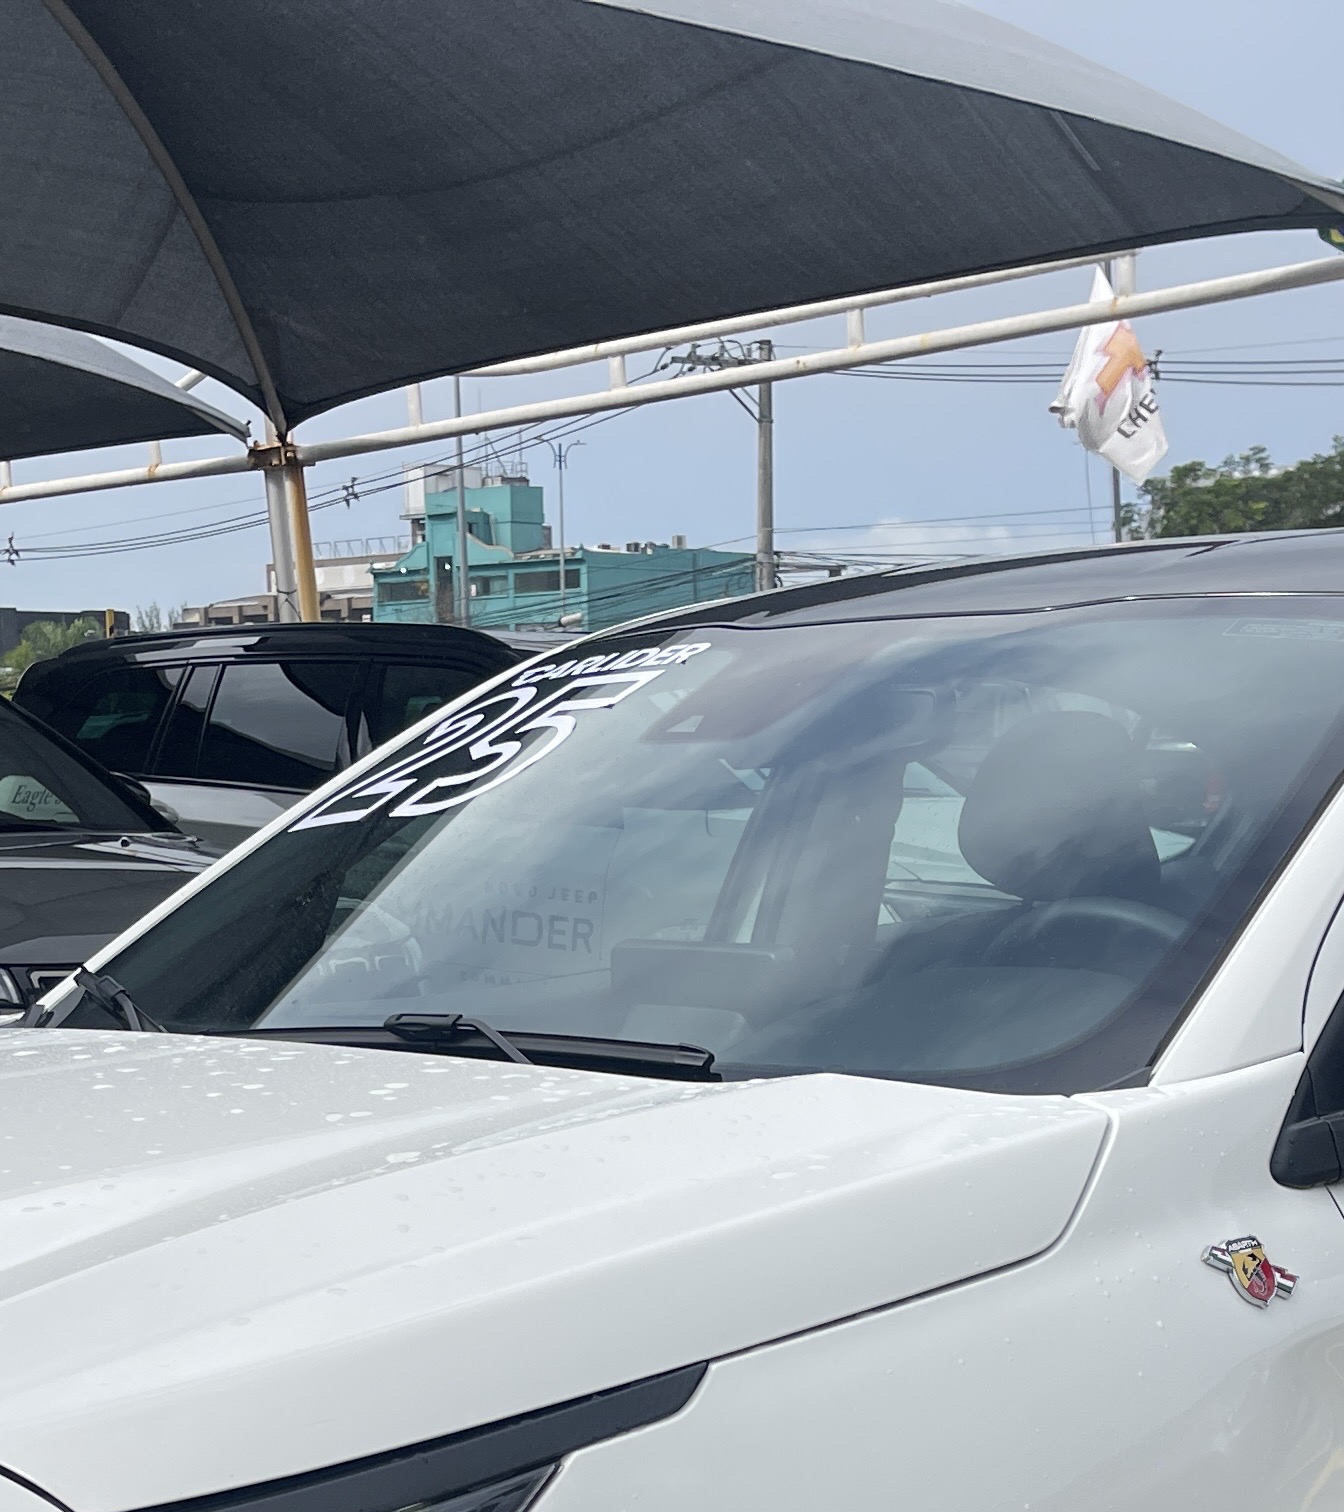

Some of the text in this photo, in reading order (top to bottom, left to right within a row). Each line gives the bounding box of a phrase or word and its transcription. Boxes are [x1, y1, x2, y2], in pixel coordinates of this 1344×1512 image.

[1117, 388, 1159, 438] CHE
[512, 642, 712, 688] CARLIDER
[547, 886, 598, 904] JEEP
